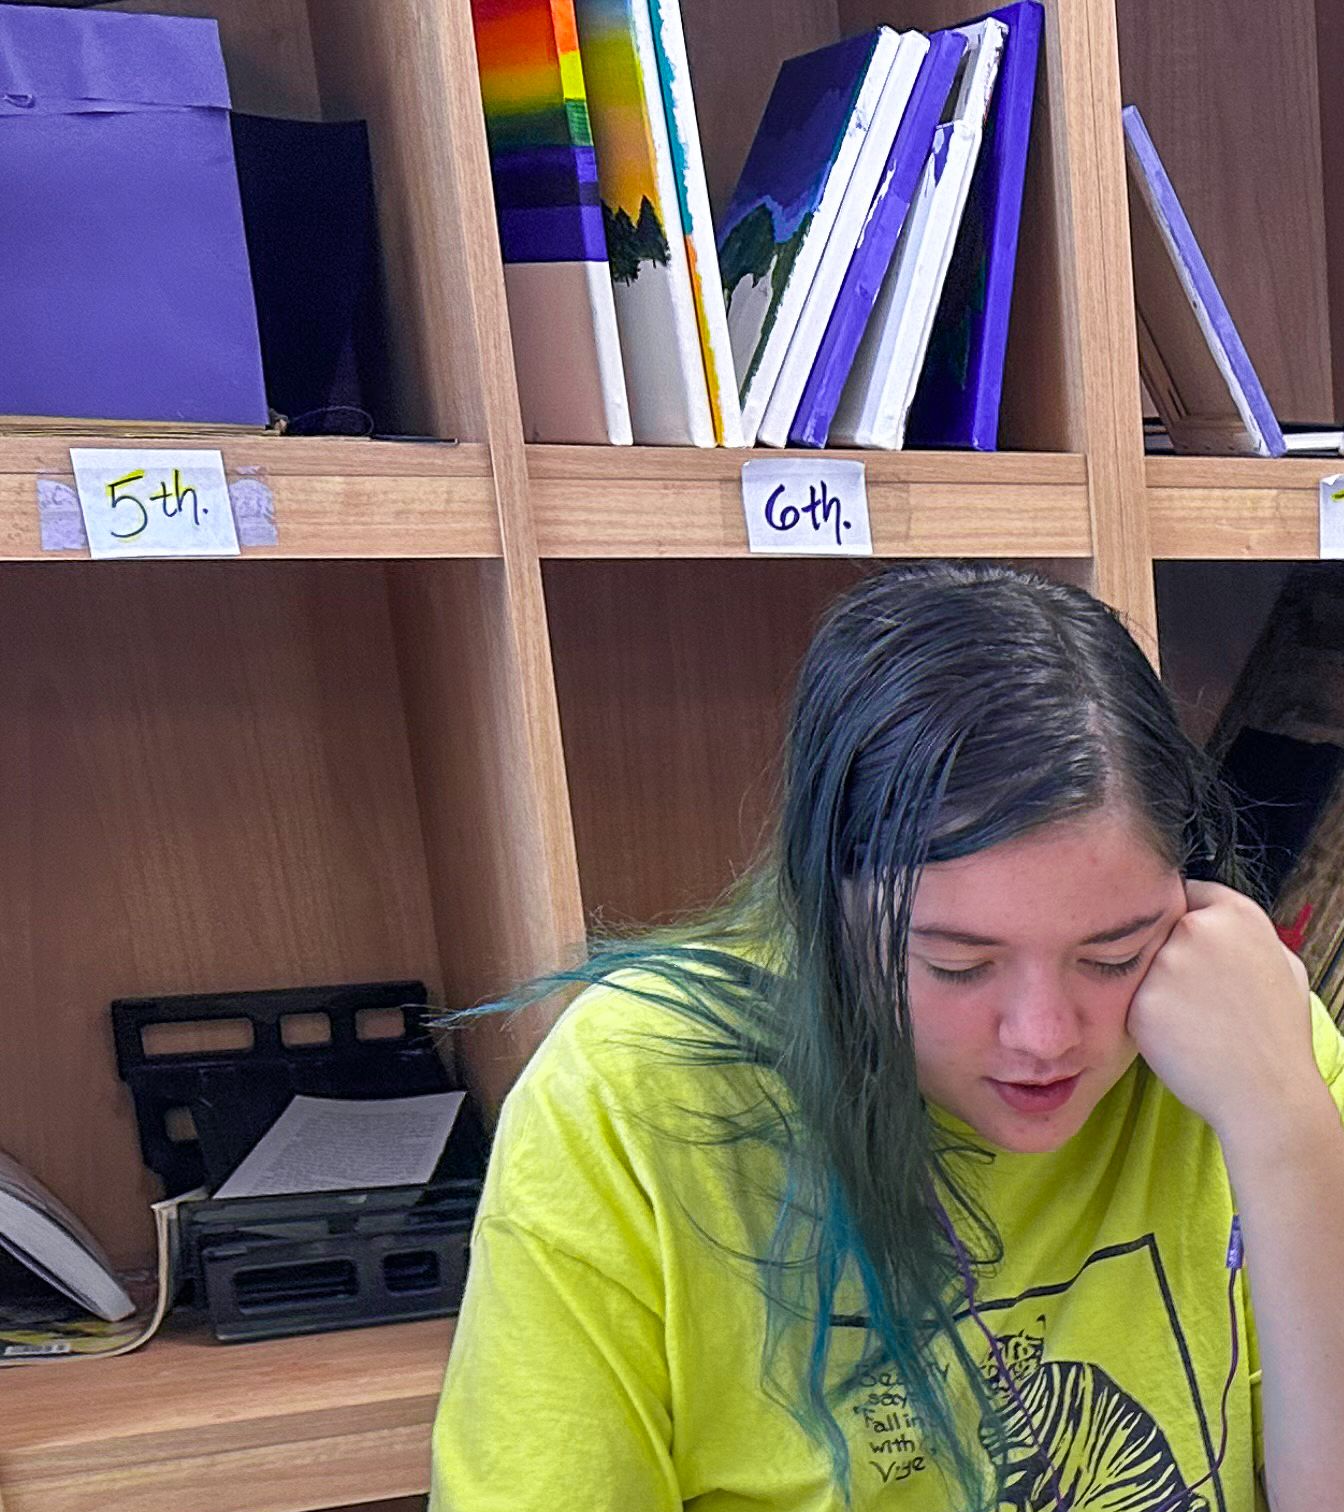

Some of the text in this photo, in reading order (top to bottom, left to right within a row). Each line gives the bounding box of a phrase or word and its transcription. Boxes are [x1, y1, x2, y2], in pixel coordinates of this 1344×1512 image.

[107, 469, 209, 540] 5th.
[764, 480, 852, 546] 6th.
[870, 1434, 915, 1454] with
